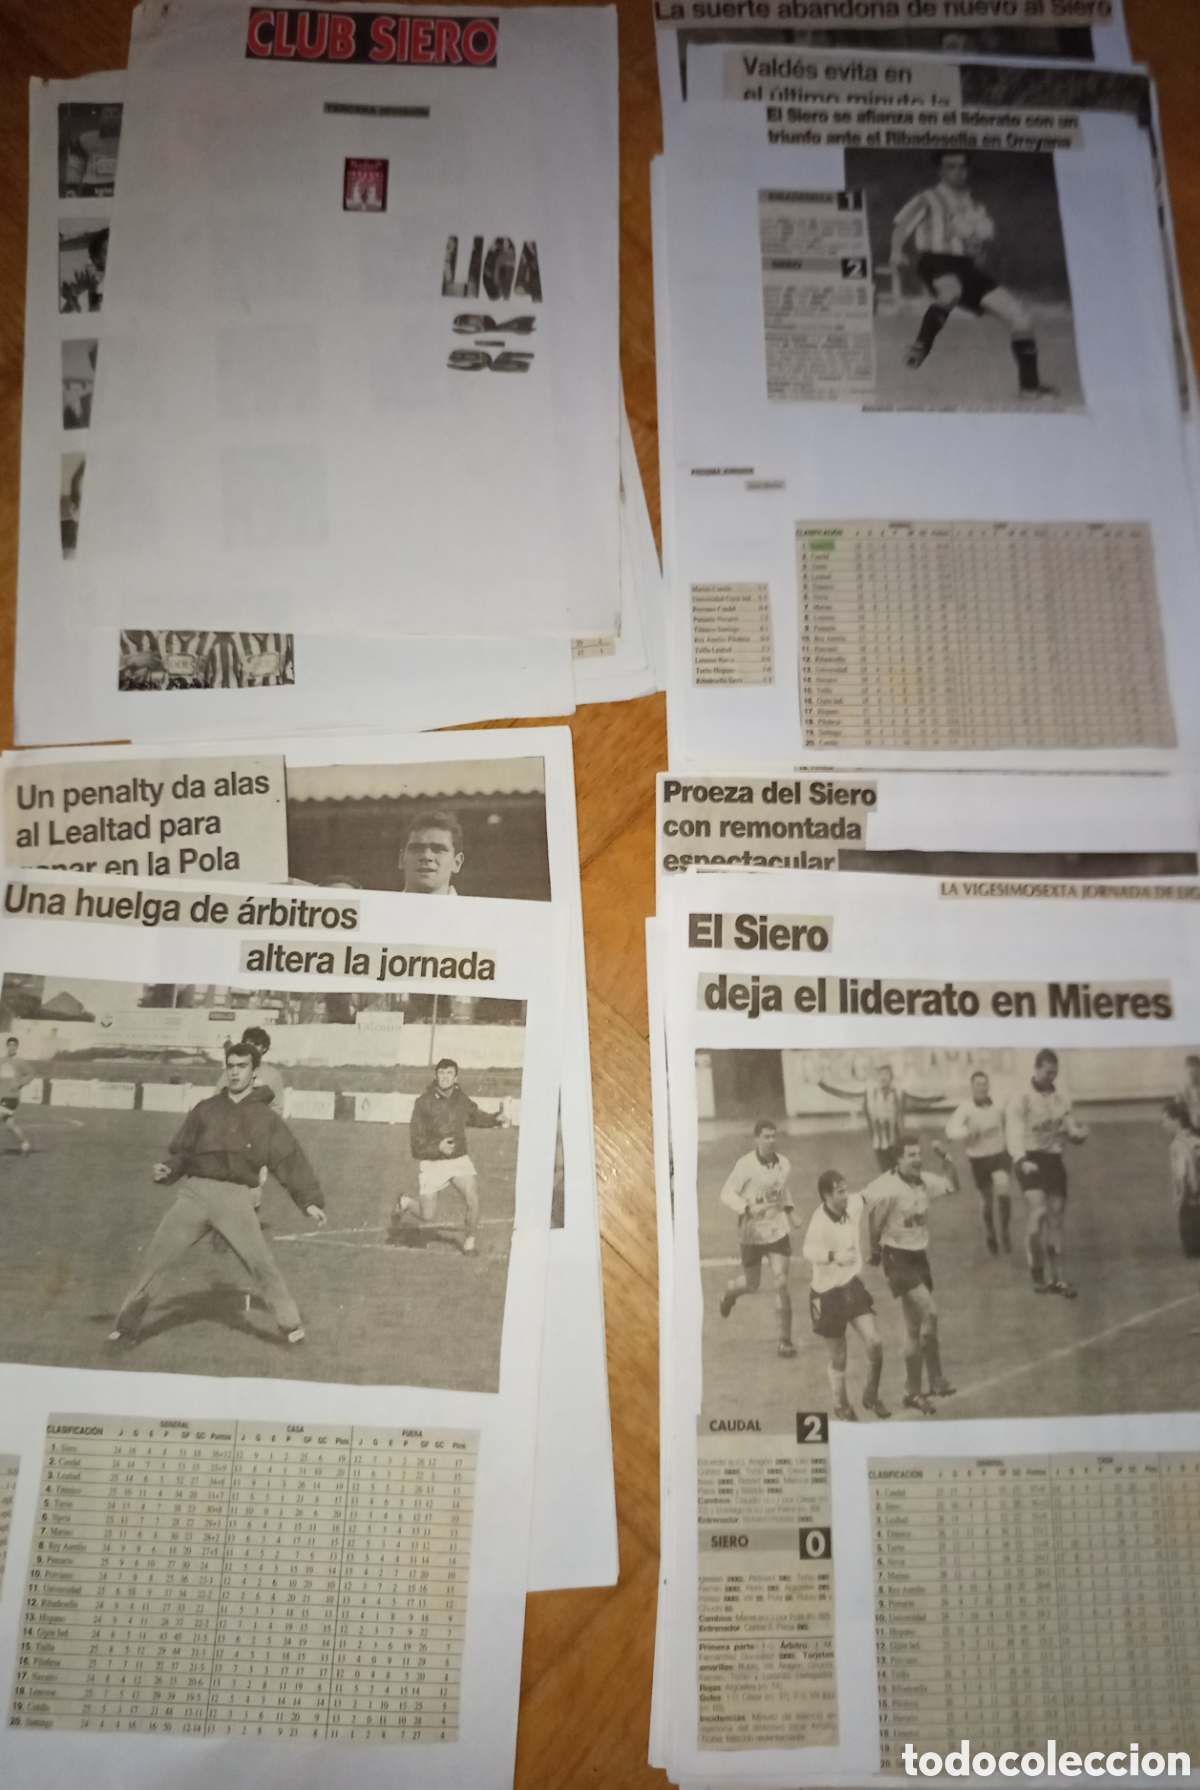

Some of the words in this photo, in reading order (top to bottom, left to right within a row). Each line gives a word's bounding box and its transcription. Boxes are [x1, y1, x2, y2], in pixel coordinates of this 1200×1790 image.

[654, 0, 684, 20] La
[692, 0, 770, 19] suerte
[778, 0, 900, 19] abandona
[907, 0, 936, 18] de
[944, 0, 1017, 17] nuevo
[248, 10, 355, 60] CLUB
[369, 16, 497, 64] SIERO
[743, 57, 818, 80] Valdés
[824, 61, 878, 83] evita
[884, 67, 912, 84] en
[767, 106, 781, 122] El
[787, 107, 829, 124] Siero
[833, 110, 852, 124] se
[856, 109, 913, 125] afianza
[918, 112, 938, 125] en
[942, 111, 957, 126] el
[962, 112, 1021, 127] liderato
[1025, 116, 1053, 128] con
[1058, 116, 1079, 129] un
[768, 130, 821, 145] triunfo
[826, 131, 861, 146] ante
[866, 130, 880, 146] el
[885, 131, 977, 148] Ribadesella
[982, 134, 1001, 148] en
[846, 259, 863, 278] 2
[16, 784, 55, 810] Un
[63, 778, 165, 813] penalty
[172, 774, 206, 800] da
[214, 771, 270, 798] alas
[664, 780, 754, 804] Proeza
[761, 781, 801, 805] del
[808, 781, 877, 806] Siero
[16, 822, 40, 848] al
[49, 814, 152, 846] Lealtad
[160, 815, 221, 844] para
[663, 819, 711, 838] con
[719, 817, 861, 840] remontada
[148, 851, 171, 876] la
[179, 846, 241, 874] Pola
[941, 882, 958, 896] LA
[963, 883, 1076, 898] VIGESIMOSEXTA
[5, 884, 65, 915] Una
[75, 888, 181, 926] huelga
[190, 895, 229, 924] de
[237, 897, 358, 930] árbitros
[689, 913, 722, 948] El
[734, 914, 829, 951] Siero
[246, 943, 334, 974] altera
[344, 946, 370, 975] la
[377, 947, 495, 981] jornada
[704, 974, 783, 1018] deja
[794, 977, 827, 1013] el
[839, 978, 980, 1018] liderato
[991, 991, 1036, 1018] en
[1047, 982, 1173, 1020] Mieres
[47, 1425, 103, 1436] CLASIFICACIÓN
[160, 1420, 190, 1429] GENERAL
[287, 1425, 305, 1433] CASA
[402, 1429, 423, 1438] FUERA
[709, 1419, 762, 1432] CAUDAL
[803, 1415, 822, 1441] 2
[711, 1535, 749, 1548] SIERO
[806, 1531, 825, 1557] 0
